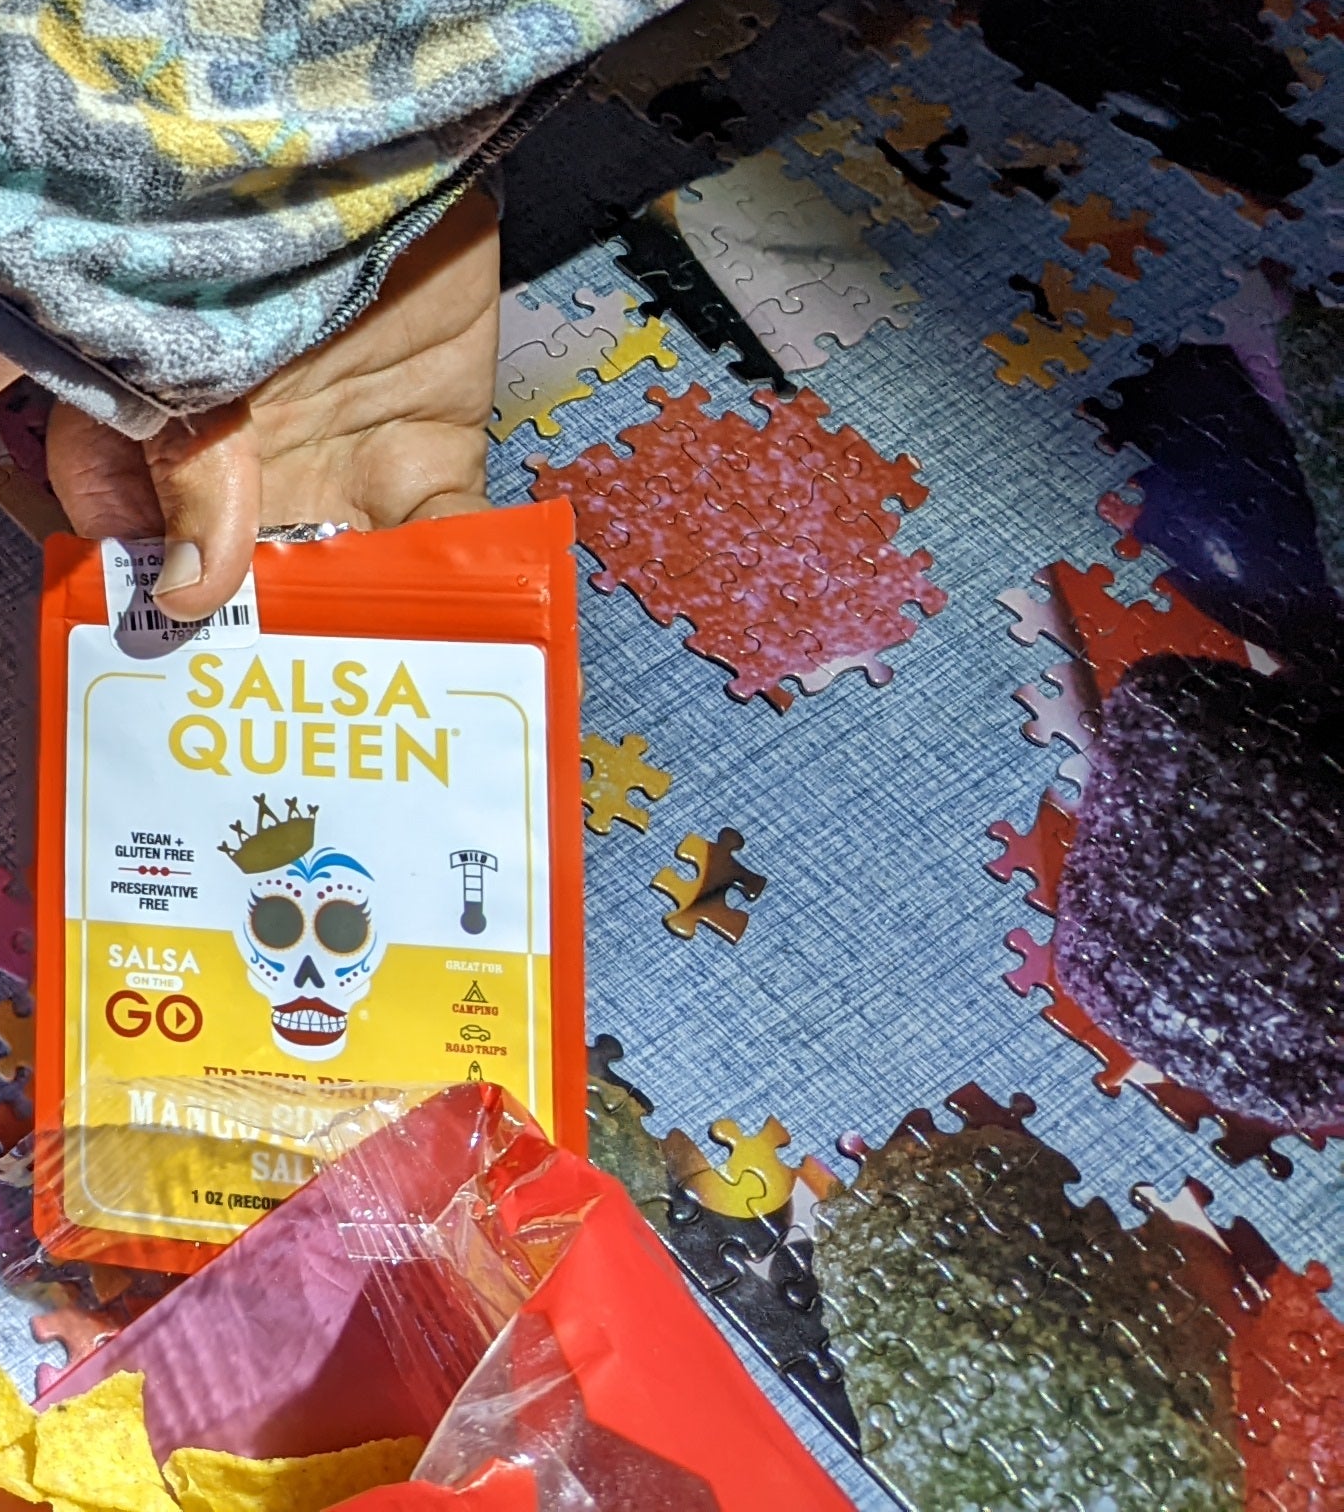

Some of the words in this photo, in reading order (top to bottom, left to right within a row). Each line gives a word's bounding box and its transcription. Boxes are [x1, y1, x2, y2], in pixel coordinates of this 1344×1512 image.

[161, 628, 211, 641] 479323
[186, 652, 431, 719] SALSA
[131, 831, 172, 846] VEGAN
[115, 844, 161, 859] GLUTEN
[164, 848, 195, 862] FREE
[458, 852, 488, 864] MILD
[110, 880, 199, 899] PRESERVATIVE
[139, 897, 169, 911] FREE
[108, 943, 200, 974] SALSA
[445, 960, 480, 972] GREAT
[482, 962, 503, 975] FOR
[132, 976, 150, 985] ON
[153, 977, 175, 988] THE
[105, 989, 203, 1042] GO
[452, 1003, 499, 1016] CAMPING
[445, 1042, 474, 1054] ROAD
[475, 1045, 508, 1056] TRIPS
[251, 1151, 309, 1185] SAL
[191, 1190, 199, 1203] 1
[205, 1191, 224, 1205] OZ
